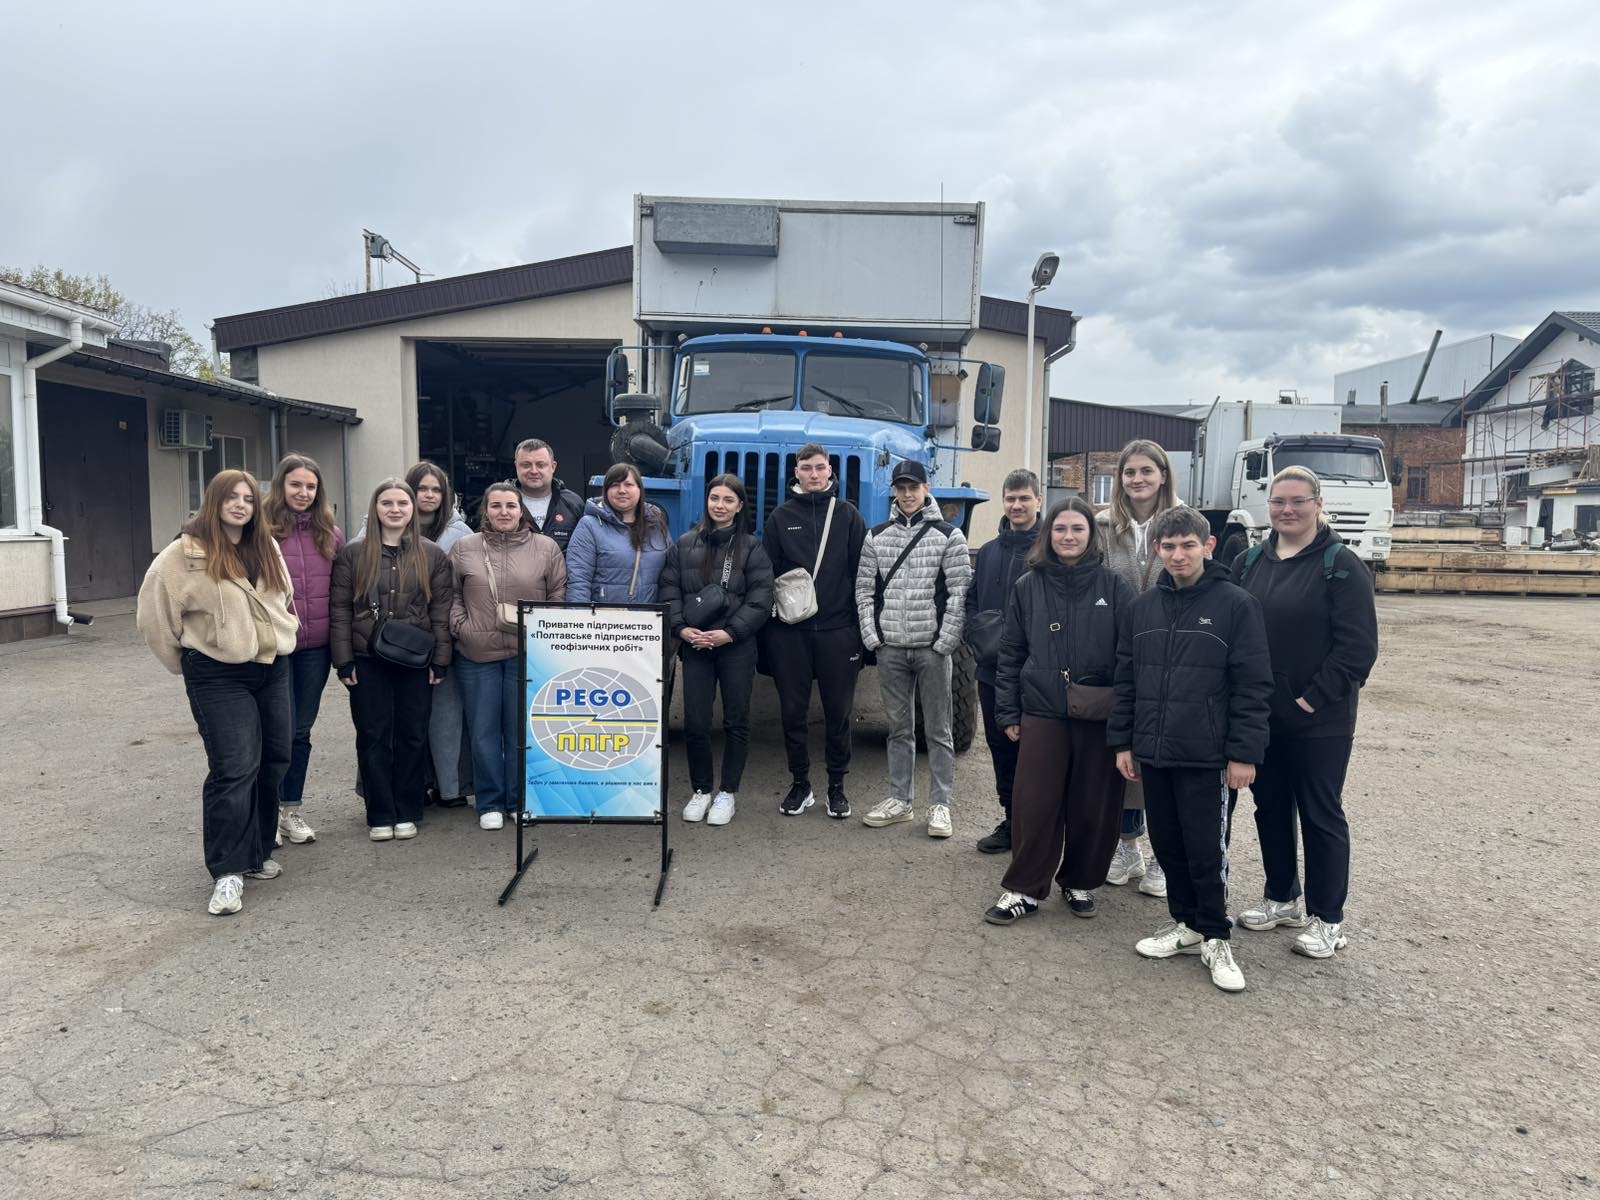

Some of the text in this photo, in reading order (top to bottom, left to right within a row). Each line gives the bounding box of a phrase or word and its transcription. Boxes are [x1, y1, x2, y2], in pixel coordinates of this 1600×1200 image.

[538, 620, 653, 631] Приватне підприємство
[531, 631, 660, 642] «Полтавське підприємство
[551, 643, 643, 653] геофізичних робіт»
[556, 688, 632, 707] PEGO
[557, 733, 630, 752] ППГР
